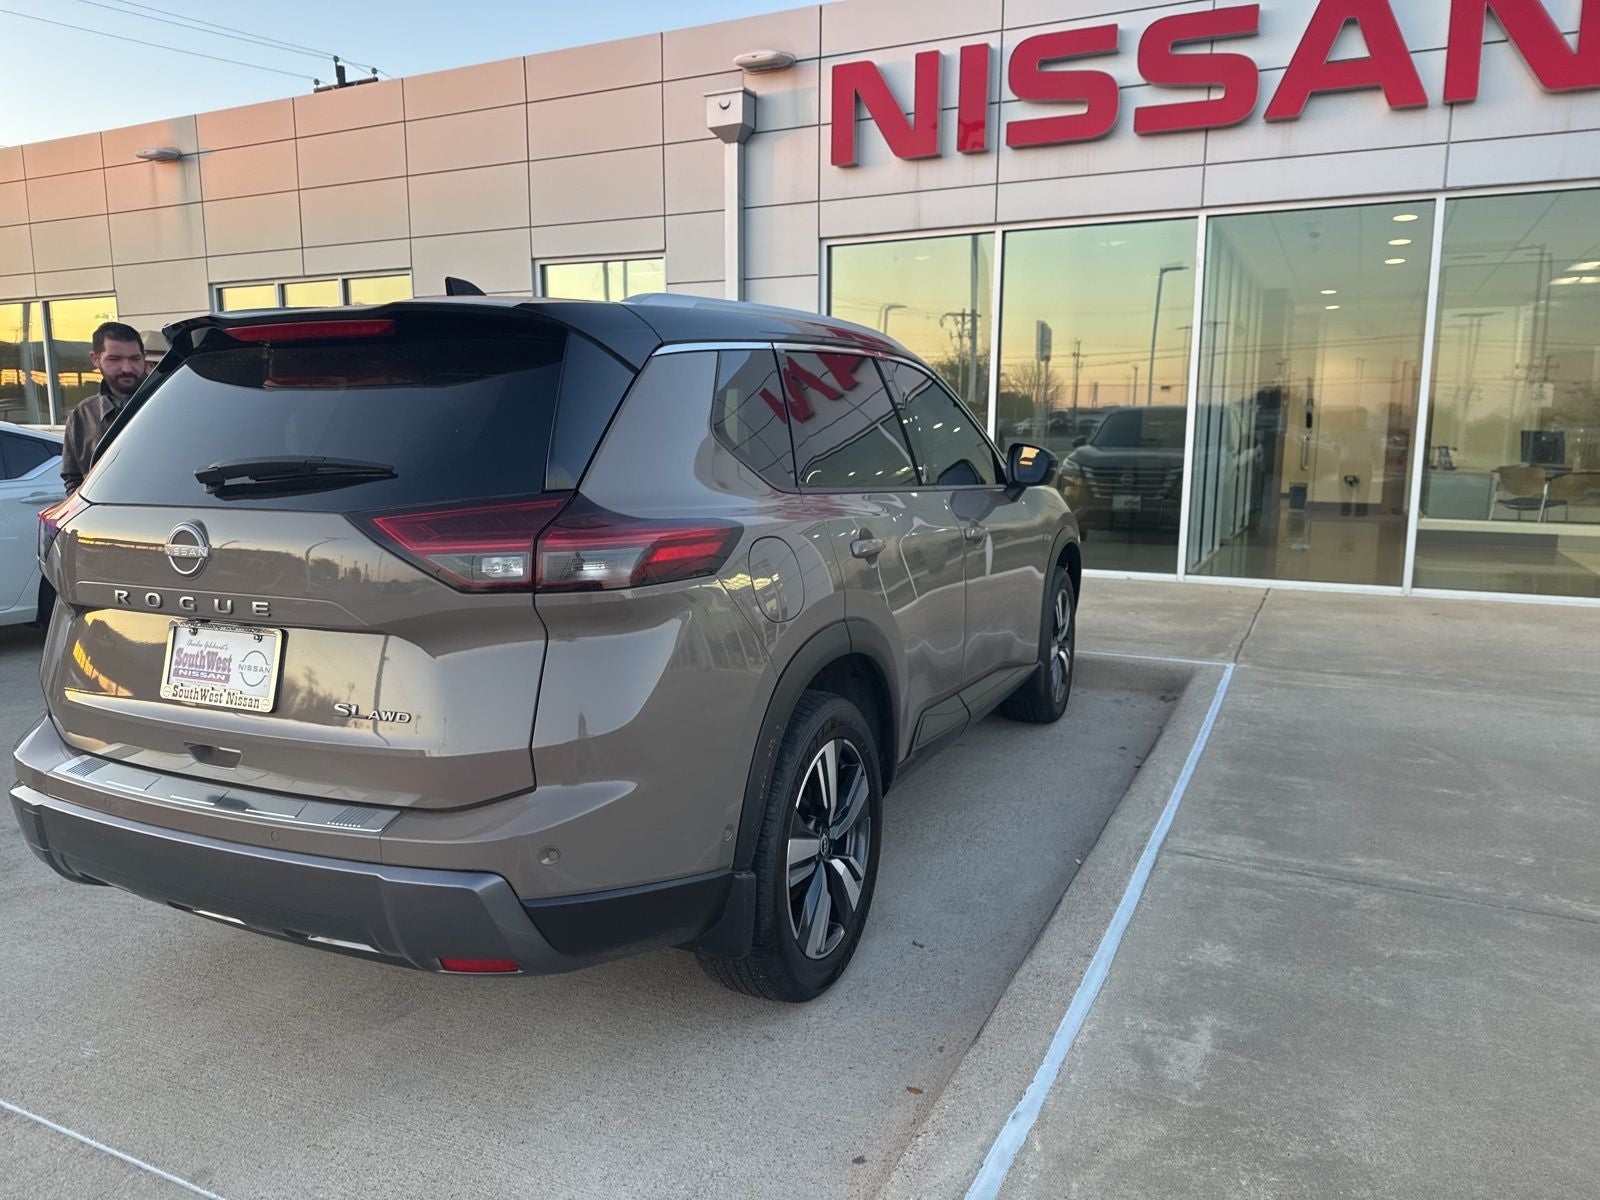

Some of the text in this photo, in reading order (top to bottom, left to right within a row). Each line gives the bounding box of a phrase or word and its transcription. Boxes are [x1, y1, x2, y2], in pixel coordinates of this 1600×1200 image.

[831, 0, 1600, 167] NISSAN
[114, 589, 272, 617] ROGUE
[174, 646, 232, 674] SouthWest
[238, 664, 271, 674] NISSAN
[178, 669, 226, 681] NISSAN
[172, 684, 260, 709] SouthWest Nissan
[368, 710, 411, 723] AWD
